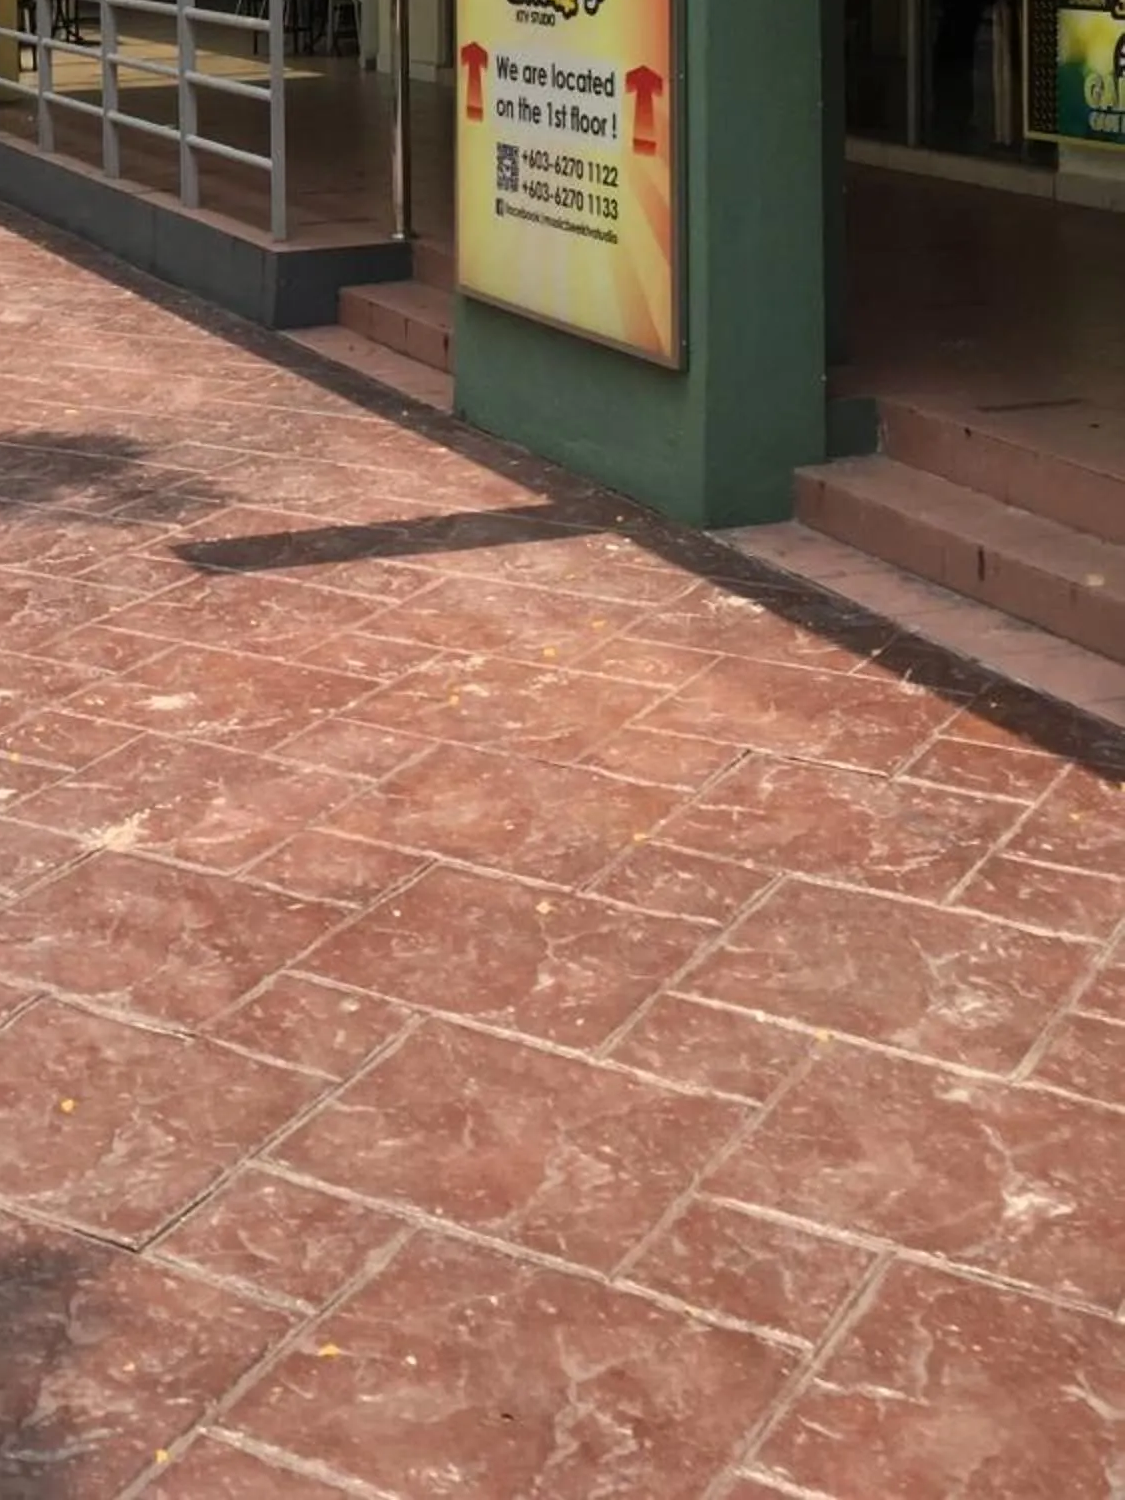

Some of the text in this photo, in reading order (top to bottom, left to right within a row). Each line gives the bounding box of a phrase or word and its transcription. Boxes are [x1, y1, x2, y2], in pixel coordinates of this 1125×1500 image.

[496, 55, 615, 97] We are located
[496, 98, 514, 119] on
[518, 97, 541, 125] the
[546, 102, 567, 130] 1st
[570, 105, 607, 136] floor
[522, 148, 619, 188] +603-6270 1122
[522, 180, 619, 221] +603-6270 1133
